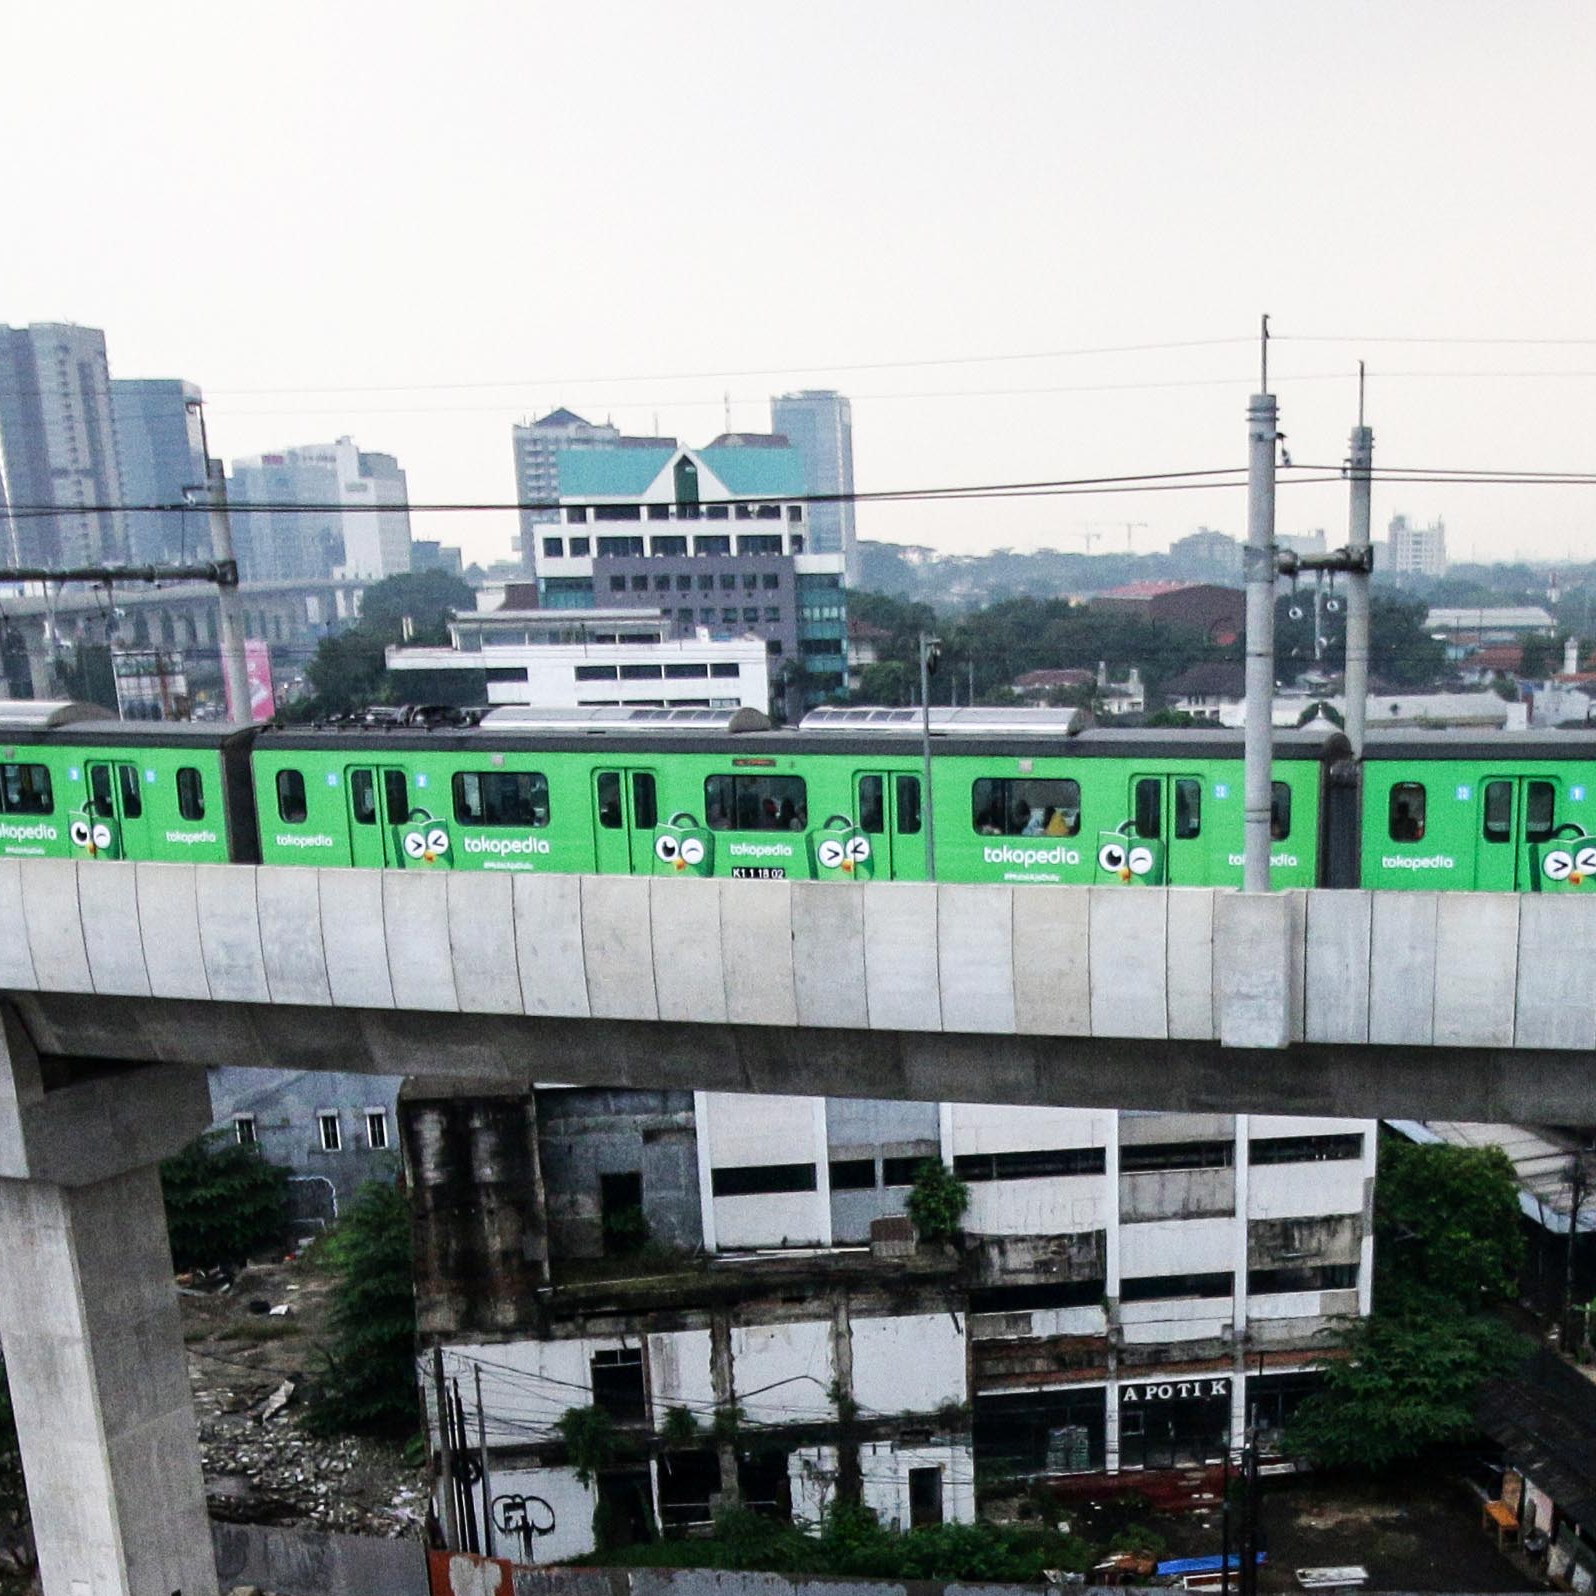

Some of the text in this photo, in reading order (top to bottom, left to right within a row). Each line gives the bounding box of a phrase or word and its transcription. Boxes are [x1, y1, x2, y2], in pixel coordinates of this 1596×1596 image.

[166, 831, 217, 845] tokopedia
[276, 834, 334, 848] tokopedia
[464, 836, 550, 857] tokopedia
[730, 842, 793, 858] tokopedia
[983, 845, 1080, 869] tokopedia
[1382, 854, 1454, 871] tokopedia
[733, 868, 746, 879] K1
[758, 868, 770, 879] 18
[771, 869, 784, 880] 02
